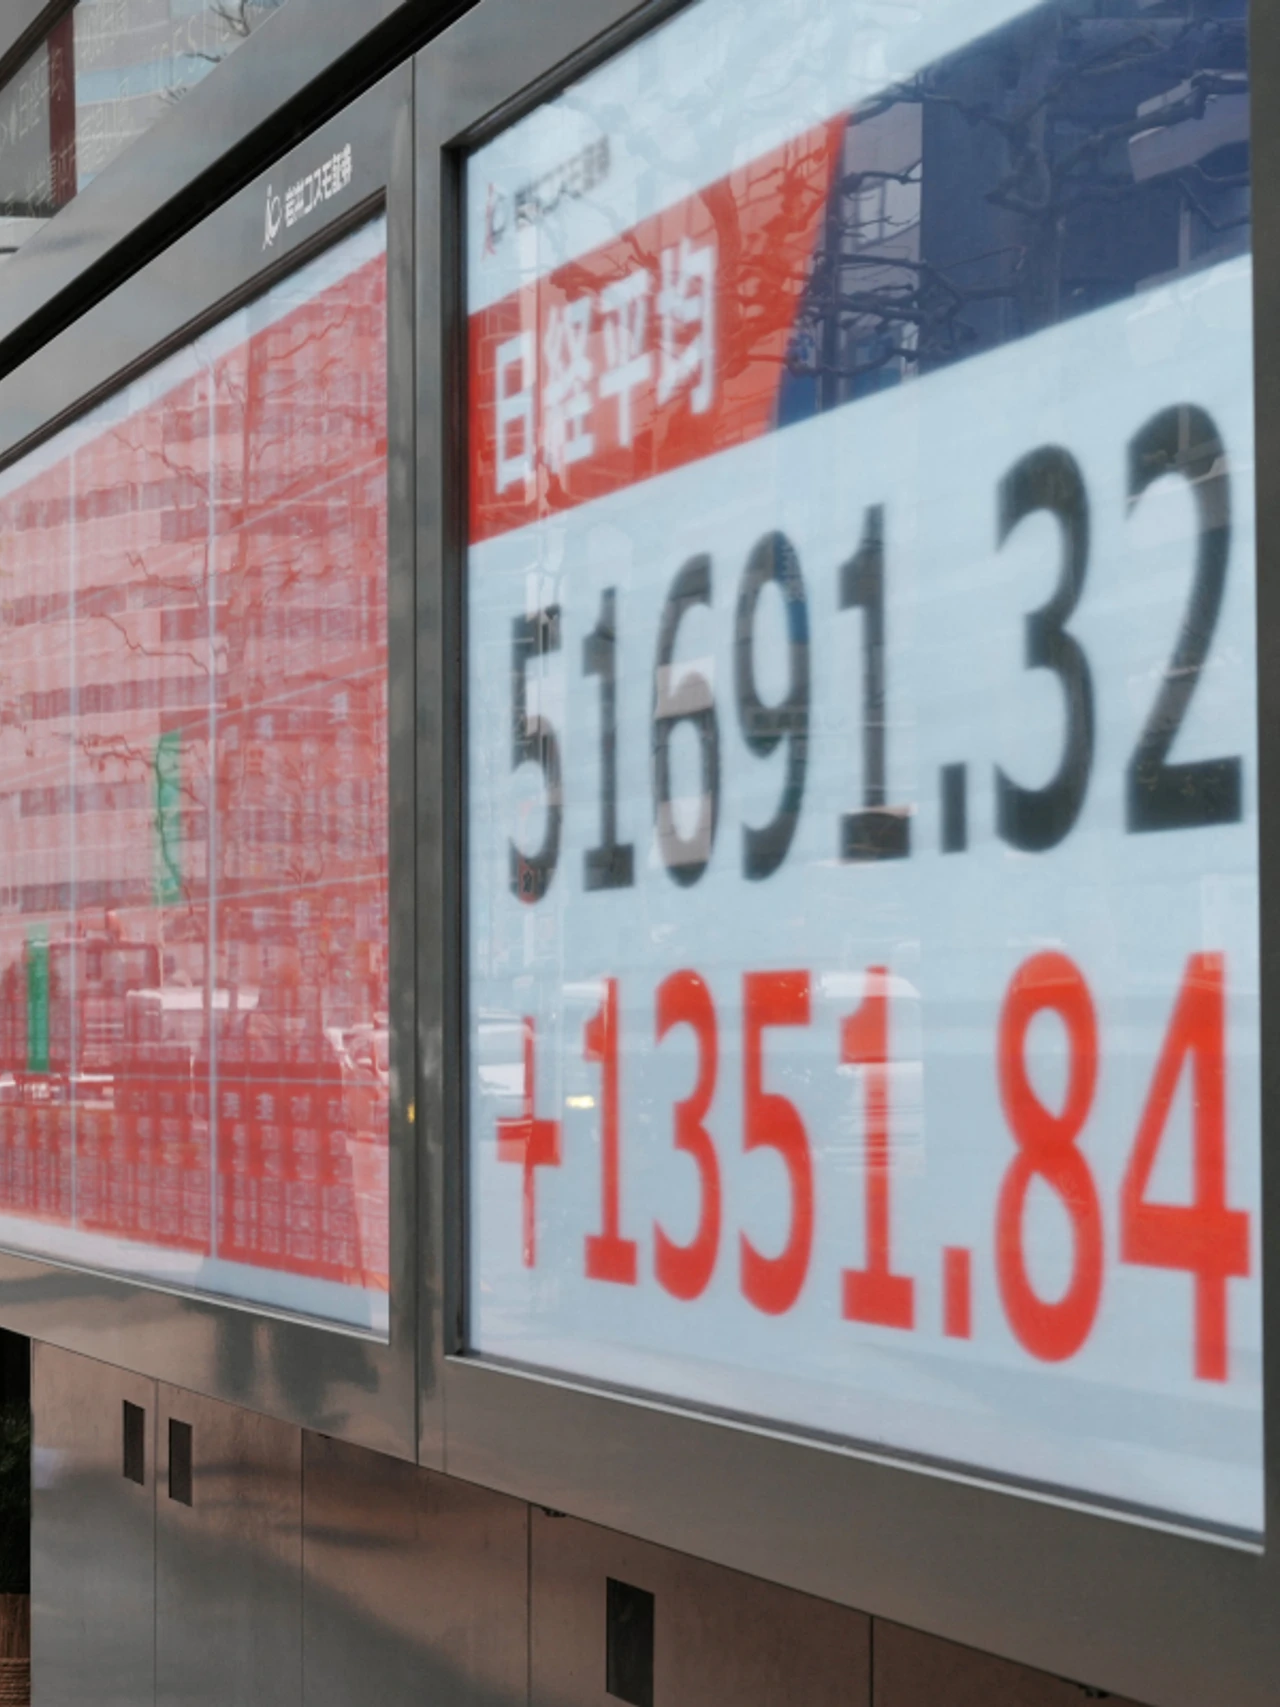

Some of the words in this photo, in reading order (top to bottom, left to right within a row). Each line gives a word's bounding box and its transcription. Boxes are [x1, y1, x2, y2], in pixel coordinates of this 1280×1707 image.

[494, 237, 717, 495] 日経平均
[508, 402, 1243, 904] 51691.32
[494, 950, 1251, 1383] +1351.84
